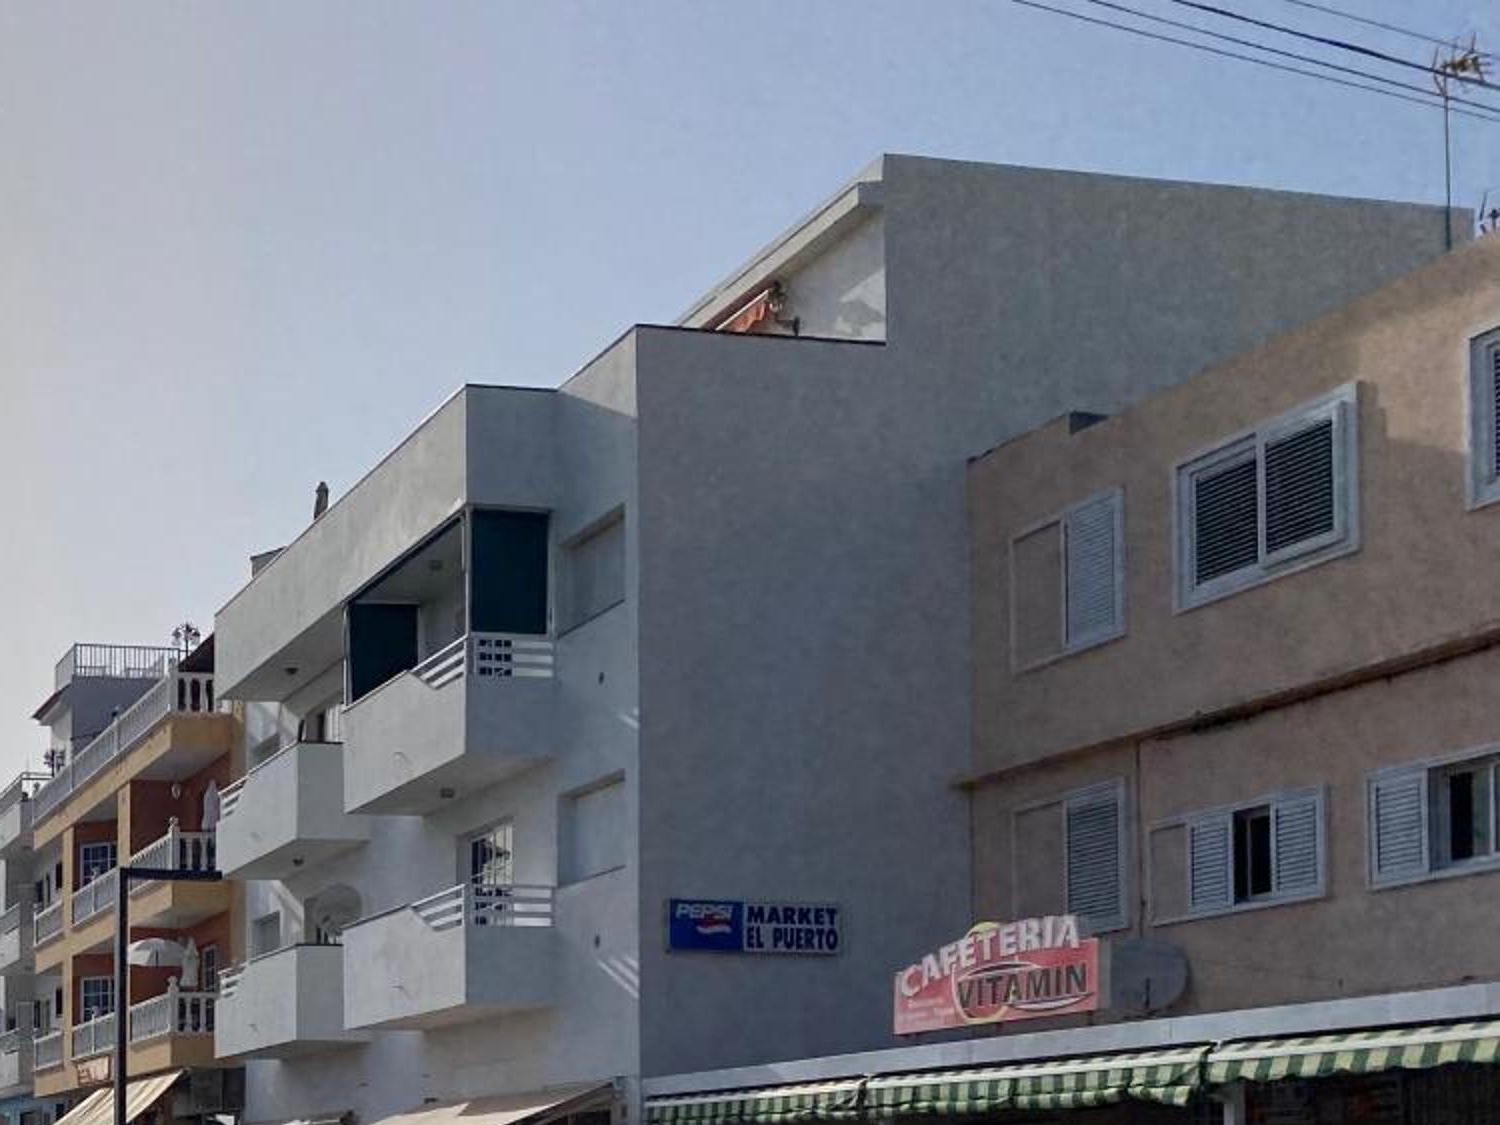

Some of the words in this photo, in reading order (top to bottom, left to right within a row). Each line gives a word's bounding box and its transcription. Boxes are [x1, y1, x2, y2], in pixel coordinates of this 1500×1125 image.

[676, 902, 735, 920] PEPSI
[747, 905, 838, 926] MARKET
[747, 926, 765, 949] EL
[773, 926, 839, 951] PUERTO
[900, 913, 1080, 997] CAFETERIA
[956, 963, 1088, 1010] VITAMIN
